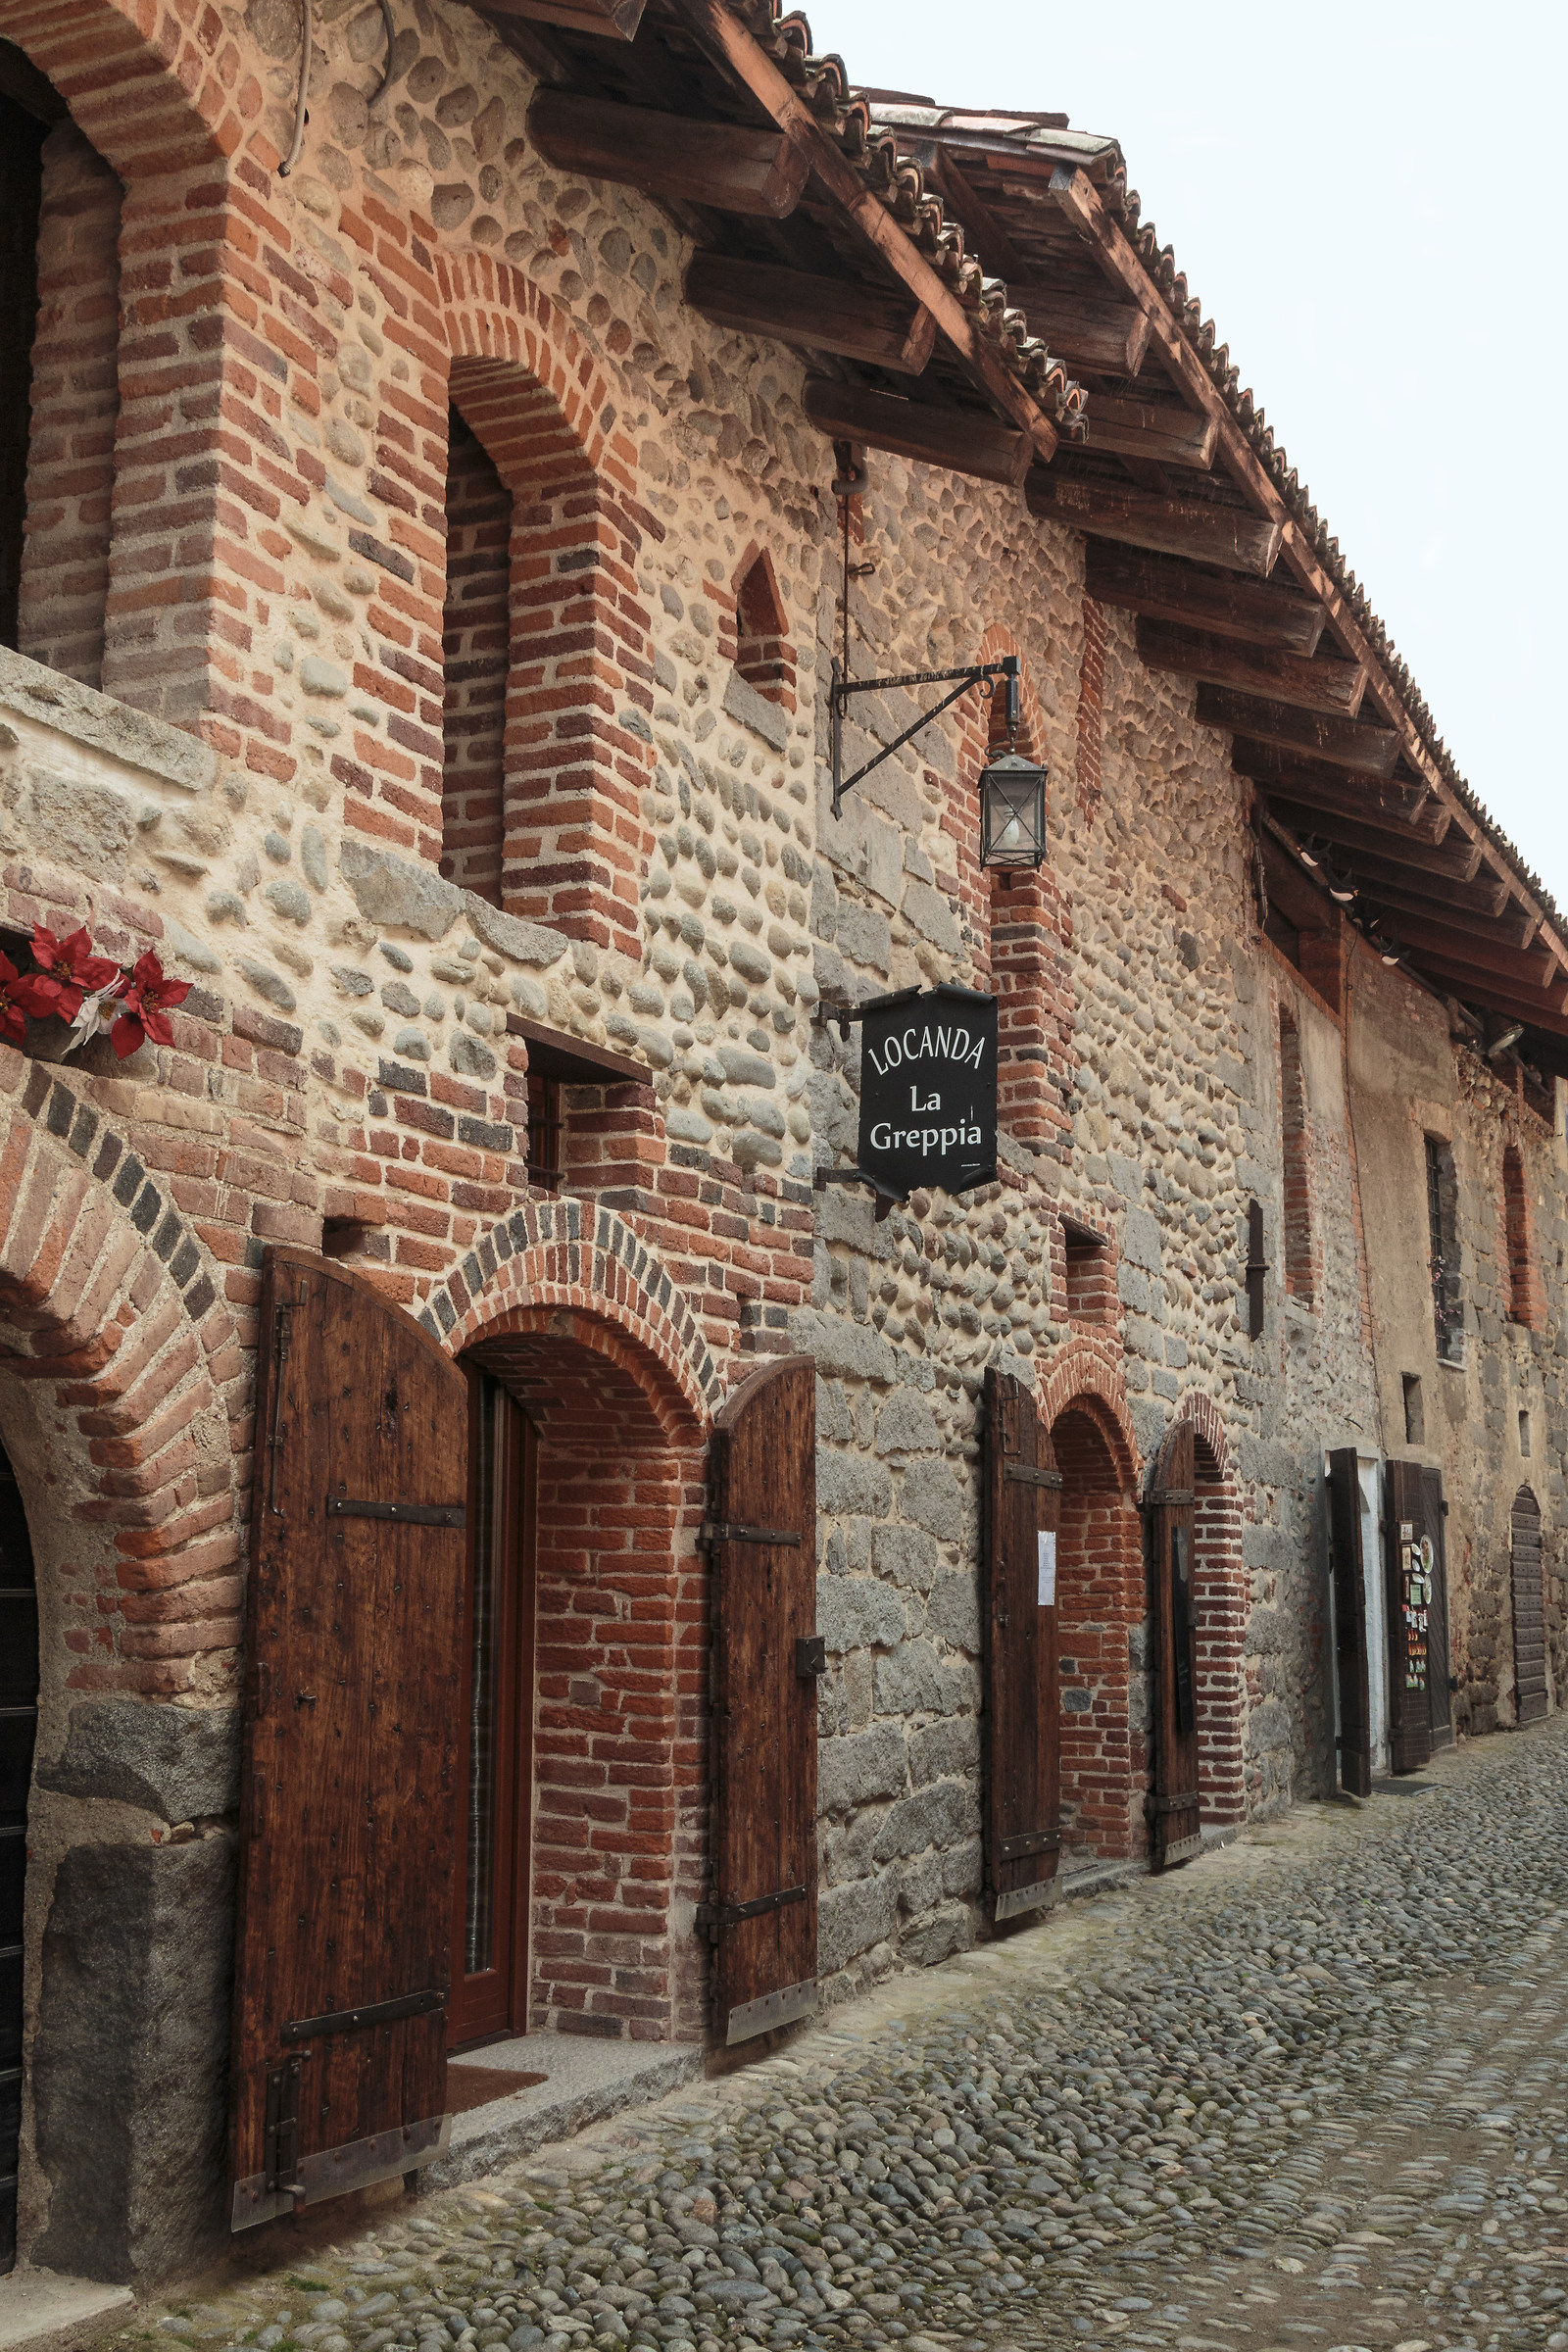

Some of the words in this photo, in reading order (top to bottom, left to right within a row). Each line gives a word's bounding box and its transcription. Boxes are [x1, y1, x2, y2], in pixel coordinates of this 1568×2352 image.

[868, 1025, 986, 1076] LOCANDA
[909, 1085, 941, 1112] La
[870, 1118, 982, 1156] Greppia
